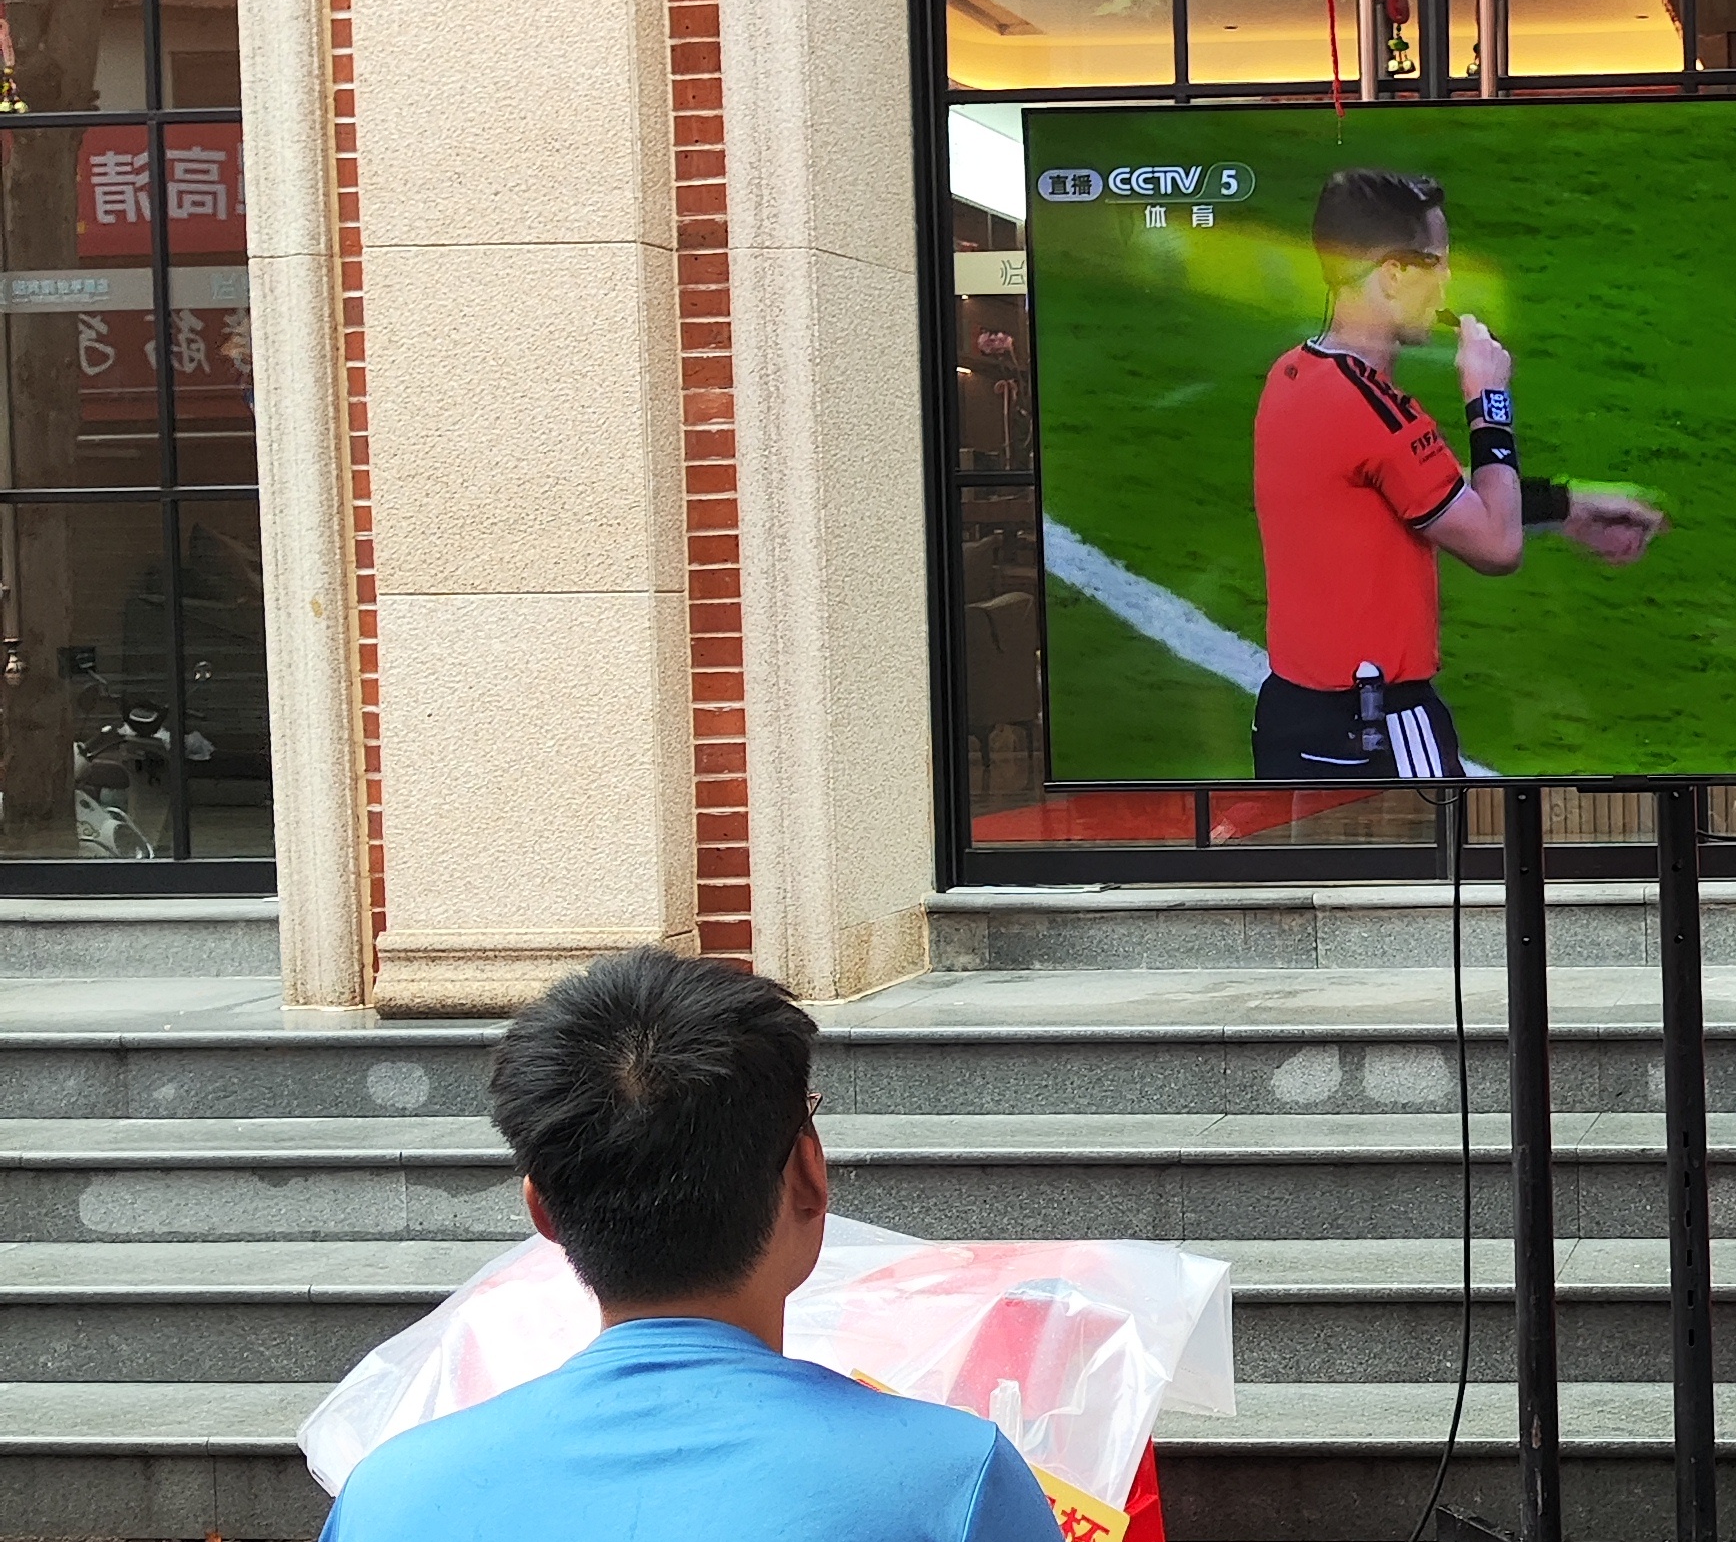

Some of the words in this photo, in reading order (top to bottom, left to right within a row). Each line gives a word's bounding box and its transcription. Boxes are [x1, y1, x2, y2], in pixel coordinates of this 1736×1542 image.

[1048, 173, 1093, 196] 直播
[1108, 165, 1203, 195] CCTV
[1219, 169, 1239, 196] 5
[1144, 204, 1214, 228] 体育
